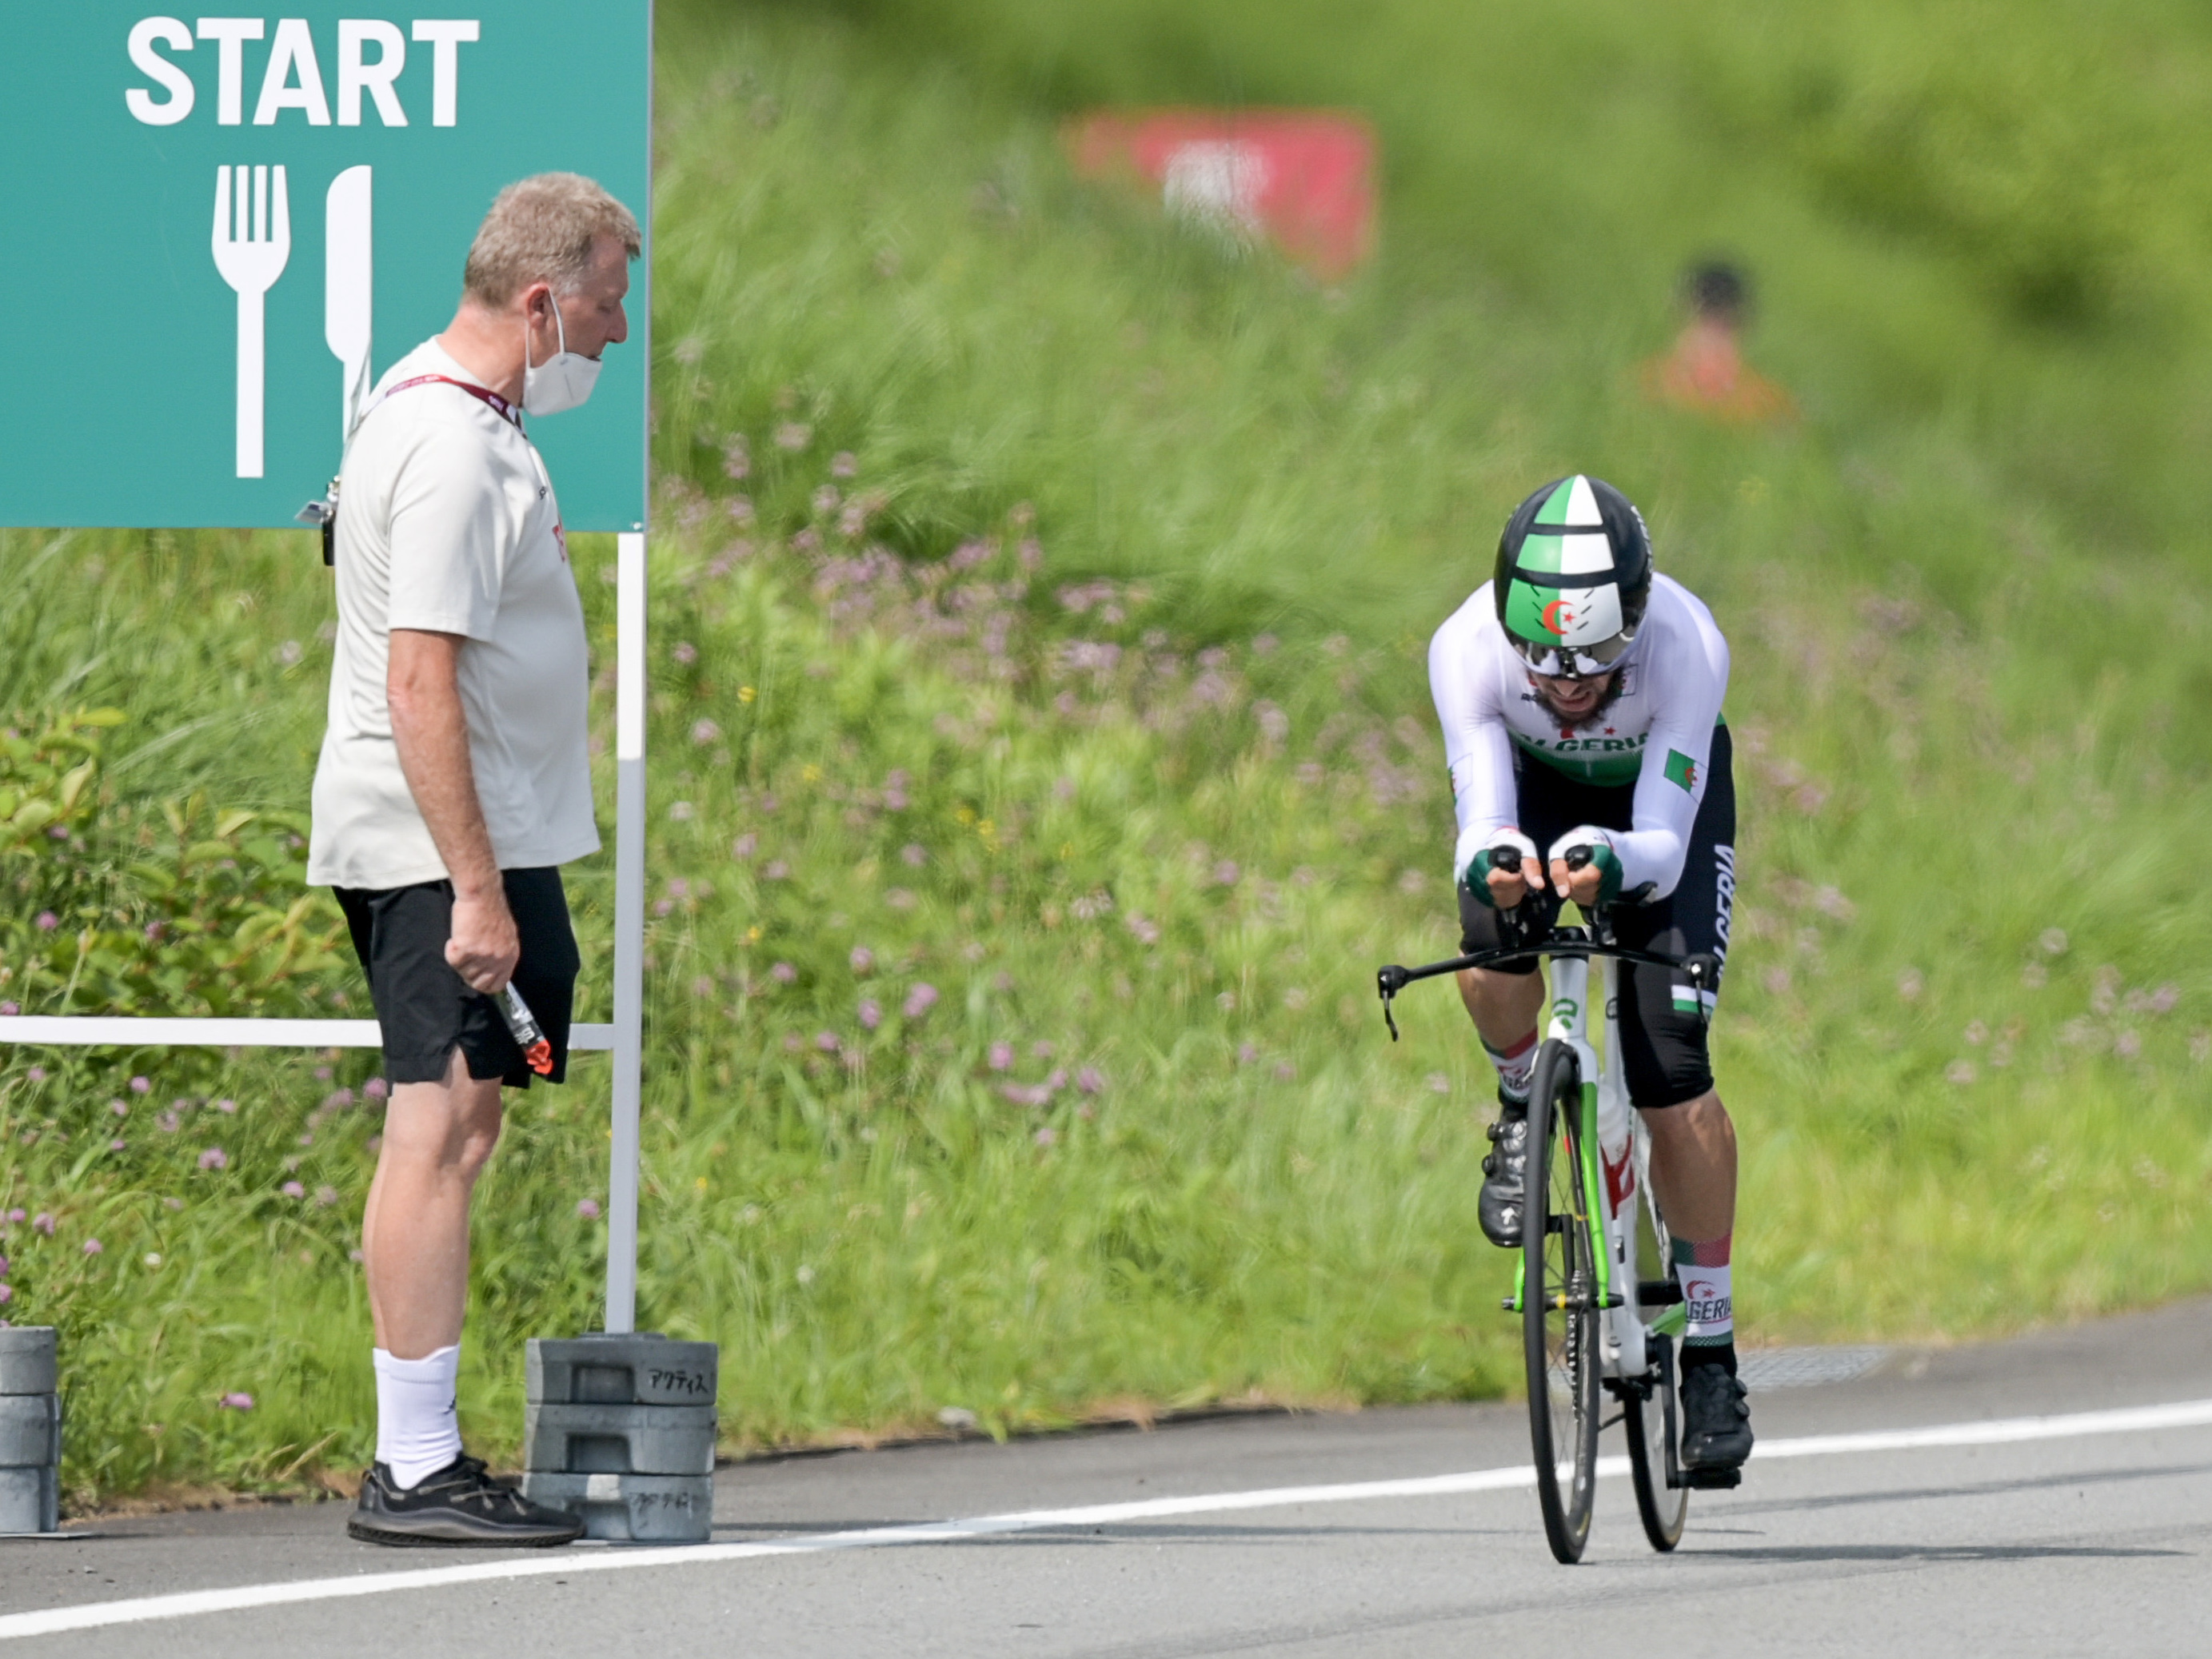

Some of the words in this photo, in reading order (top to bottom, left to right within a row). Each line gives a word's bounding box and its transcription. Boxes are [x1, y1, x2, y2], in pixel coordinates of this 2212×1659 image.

[126, 15, 480, 127] START
[1520, 732, 1649, 752] GERI
[1714, 844, 1736, 980] GERIA
